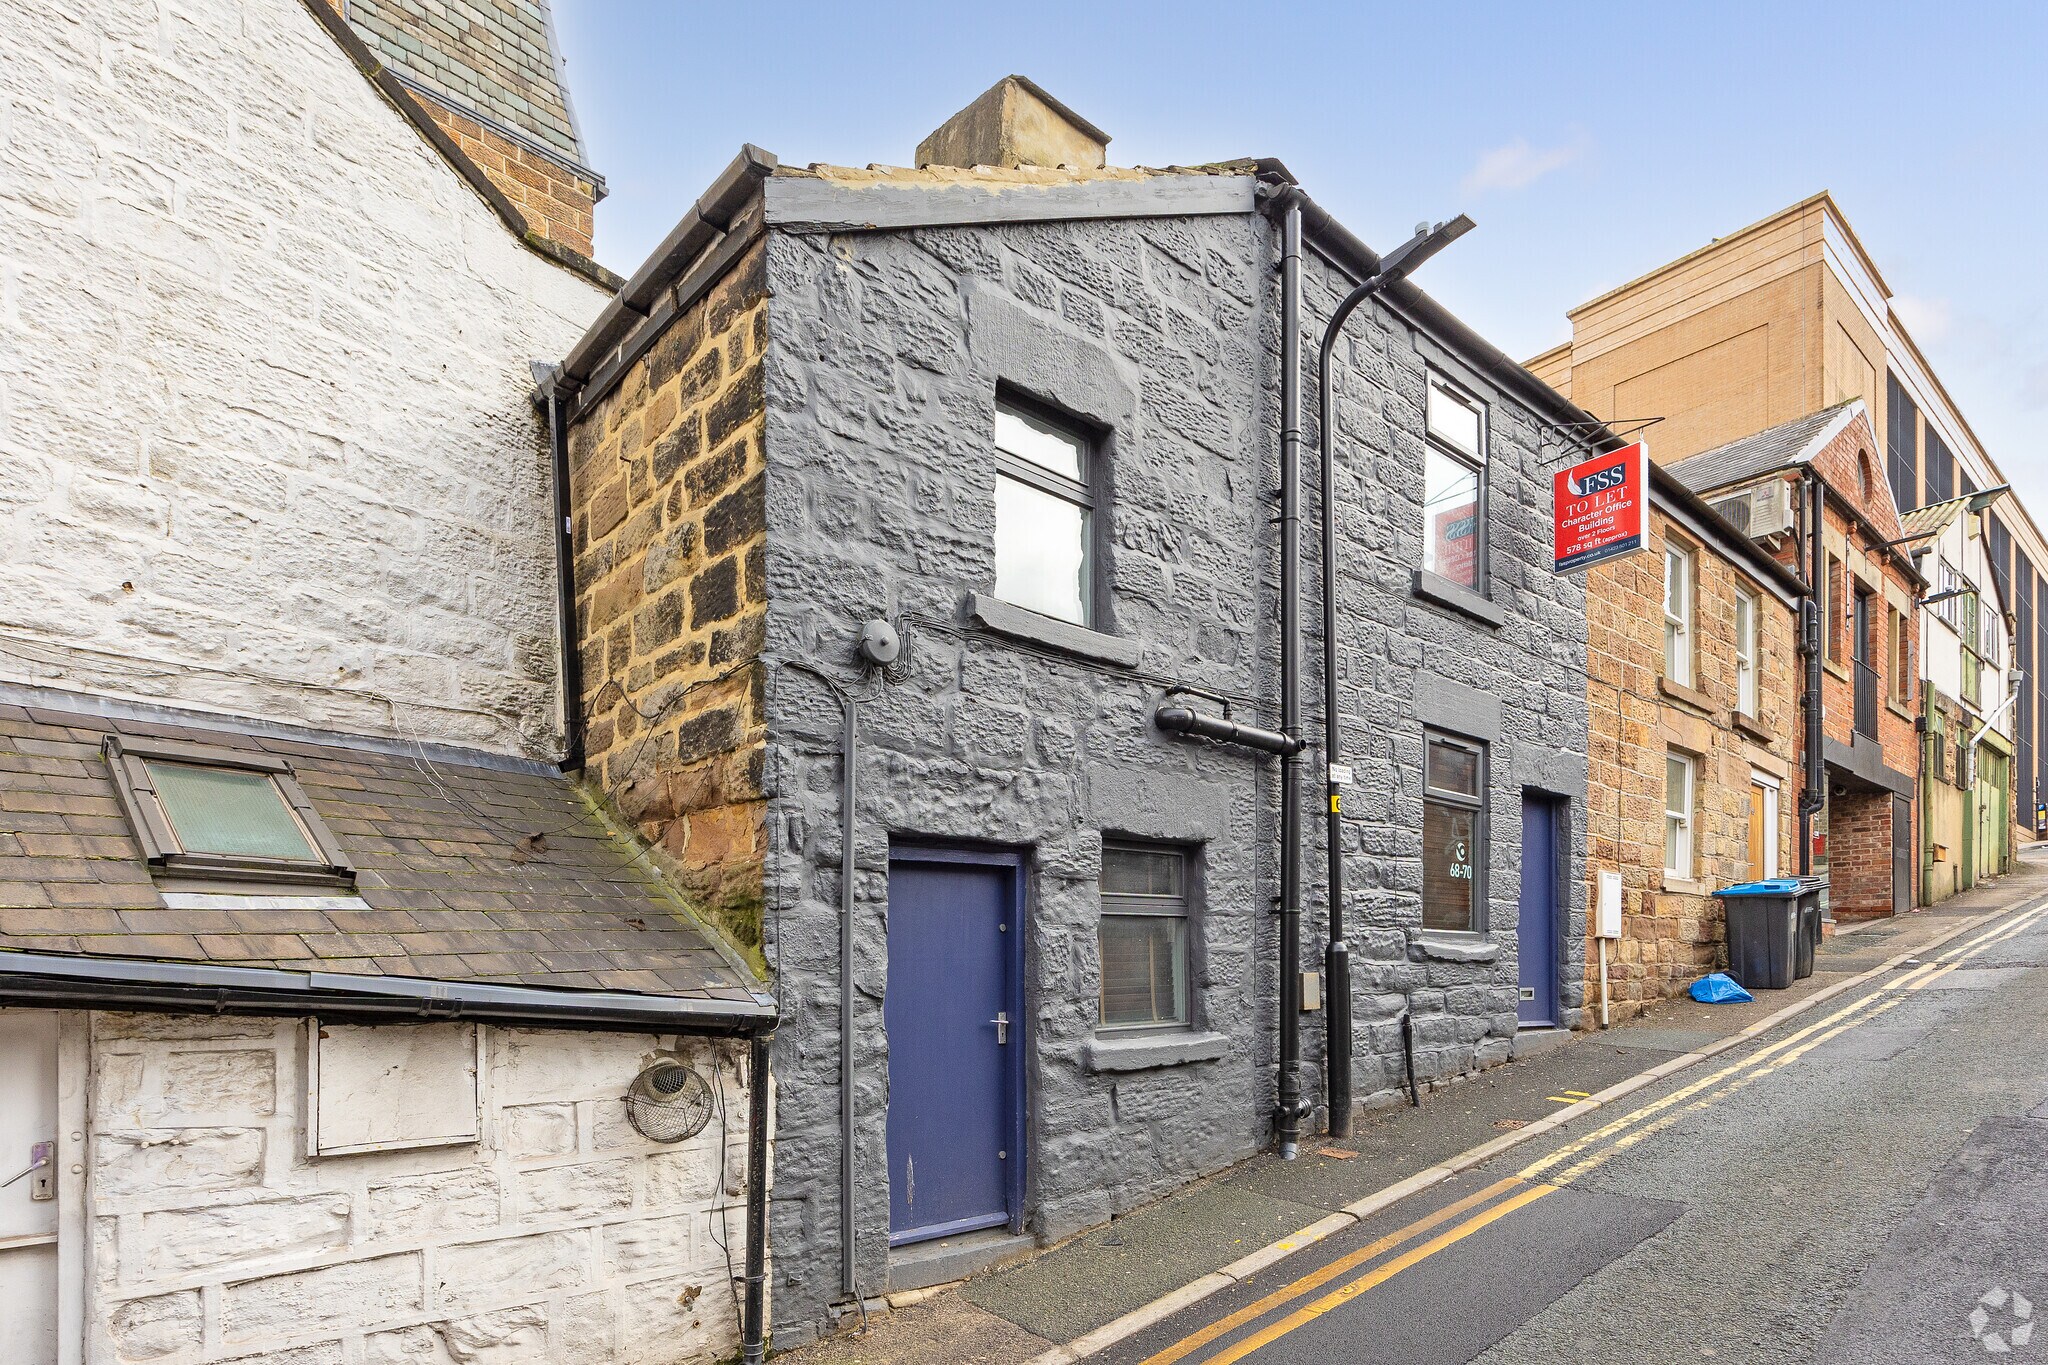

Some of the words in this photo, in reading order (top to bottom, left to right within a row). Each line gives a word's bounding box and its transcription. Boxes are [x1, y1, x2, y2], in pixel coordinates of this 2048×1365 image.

[1582, 465, 1623, 496] FSS
[1566, 500, 1588, 517] TO
[1595, 486, 1628, 509] LET
[1562, 509, 1603, 529] Character
[1605, 499, 1633, 515] Office
[1577, 532, 1591, 541] over
[1597, 525, 1616, 536] Floors
[1578, 516, 1614, 533] Building
[1566, 541, 1582, 554] 578
[1583, 539, 1593, 550] sq
[1594, 537, 1602, 546] ft
[1450, 863, 1472, 879] 68-70
